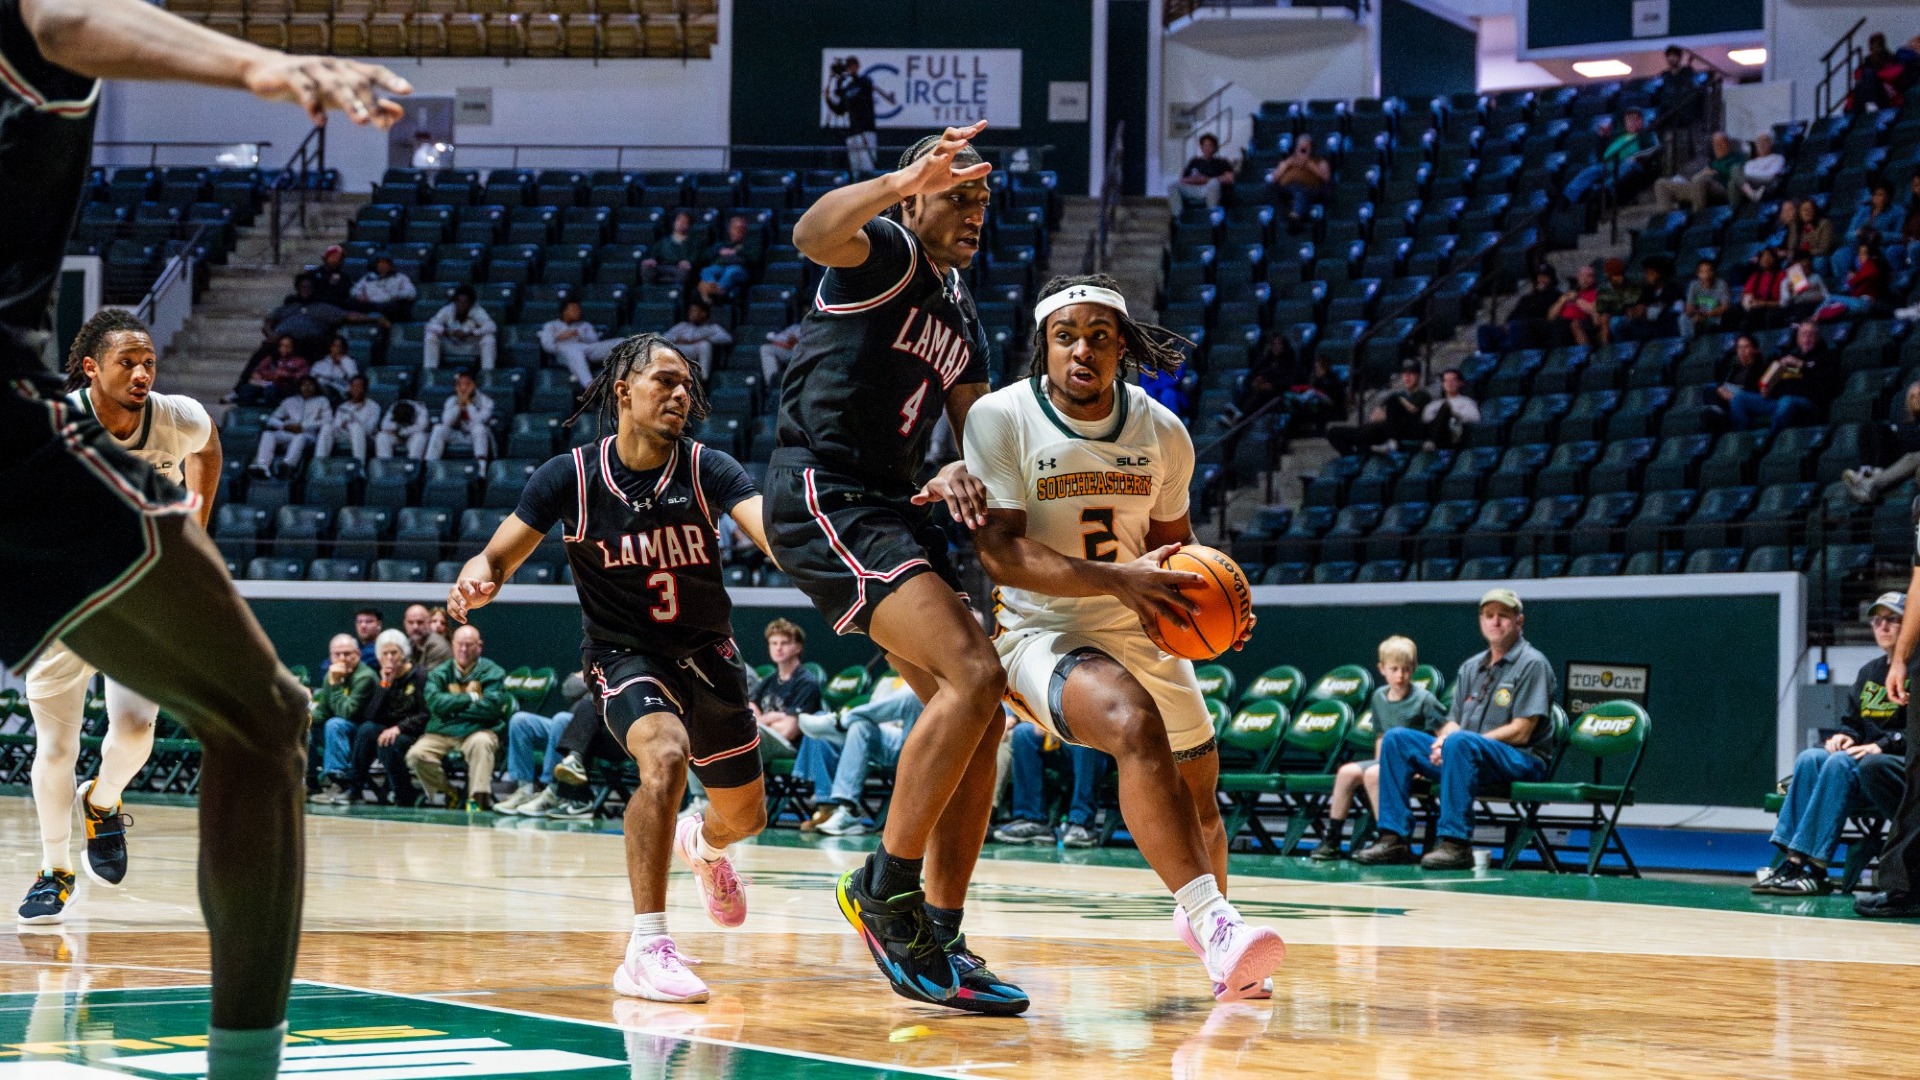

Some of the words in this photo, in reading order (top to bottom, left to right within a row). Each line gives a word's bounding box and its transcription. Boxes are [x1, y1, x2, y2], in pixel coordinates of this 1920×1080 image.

[906, 56, 987, 79] FULL
[933, 106, 986, 120] TITLE
[891, 307, 970, 391] LAMAR
[898, 378, 929, 437] 4
[1036, 471, 1153, 501] SOUTHEASTERN
[596, 524, 711, 570] LAMAR
[1079, 505, 1119, 563] 2
[646, 570, 681, 622] 3
[1572, 674, 1600, 688] TOP
[1614, 675, 1642, 690] CAT
[1579, 714, 1636, 735] Lions
